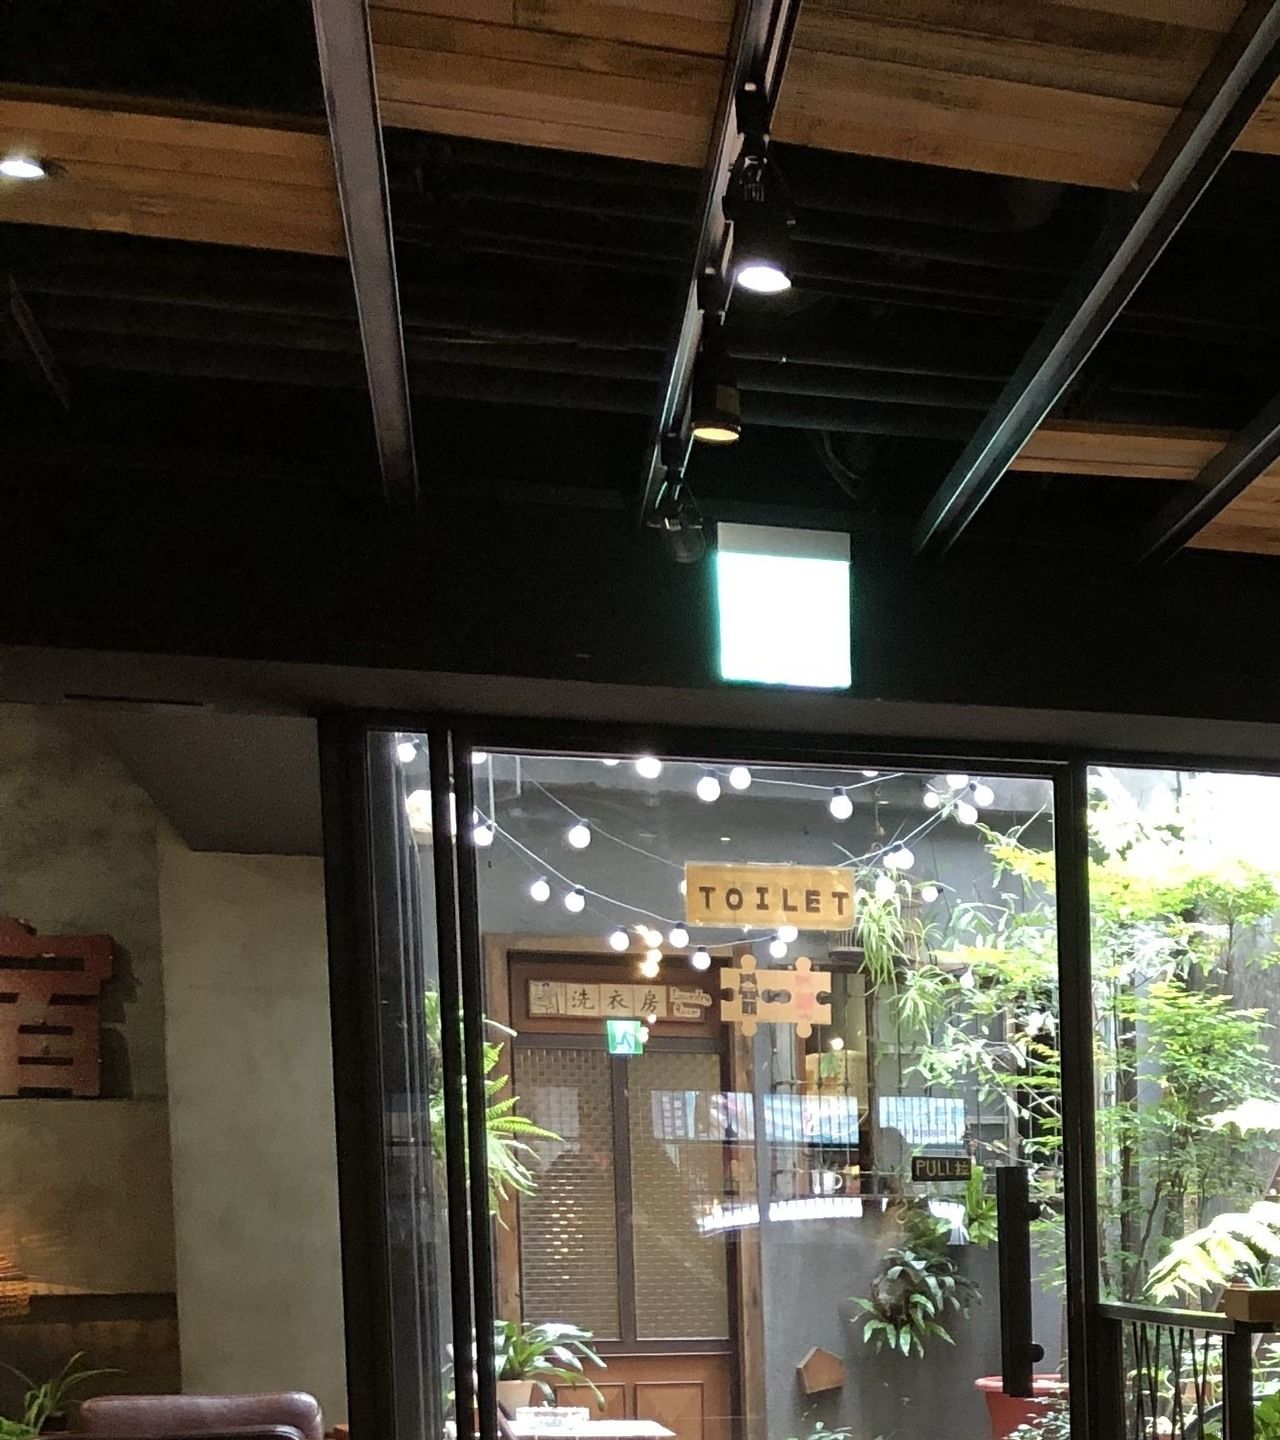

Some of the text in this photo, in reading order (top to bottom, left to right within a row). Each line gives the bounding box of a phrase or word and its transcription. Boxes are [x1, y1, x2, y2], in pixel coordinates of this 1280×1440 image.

[698, 885, 850, 916] TOILET
[571, 988, 659, 1014] 洗衣房
[915, 1159, 952, 1177] PULL
